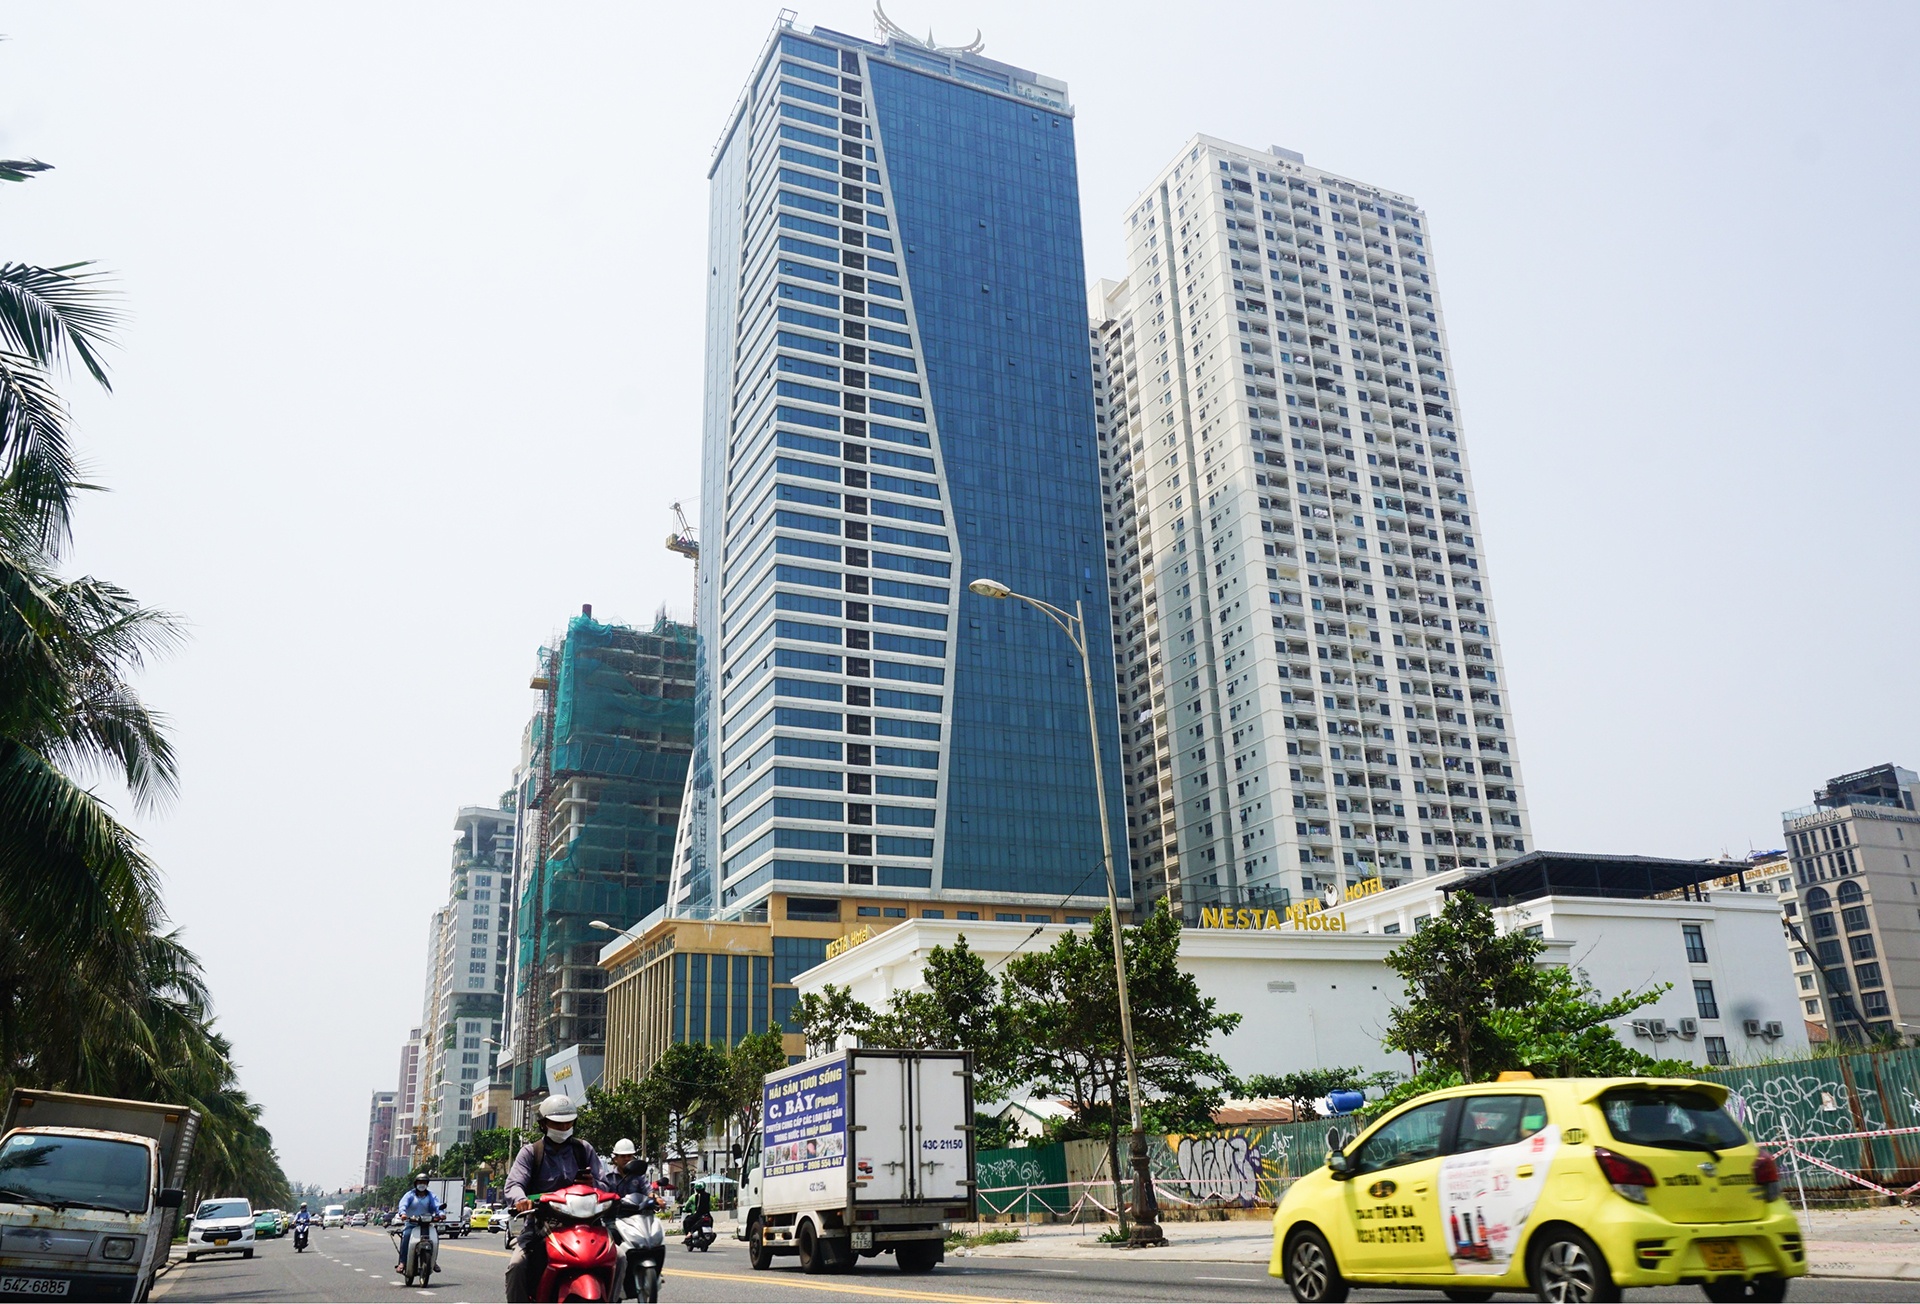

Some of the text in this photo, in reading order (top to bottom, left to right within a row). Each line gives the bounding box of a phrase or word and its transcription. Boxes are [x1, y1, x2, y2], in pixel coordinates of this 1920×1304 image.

[1793, 809, 1840, 829] HALINA
[1851, 808, 1880, 820] HALINA
[1745, 870, 1762, 880] LINE
[1763, 864, 1789, 877] HOTEL
[1285, 877, 1385, 920] NESTA HOTEL
[1202, 907, 1347, 932] NESTA Hotel
[826, 924, 870, 960] NESTA Hotel
[769, 1067, 842, 1100] HẢI SẢN TƯƠI SỐNG
[769, 1104, 782, 1119] C.
[785, 1092, 816, 1116] BẢY
